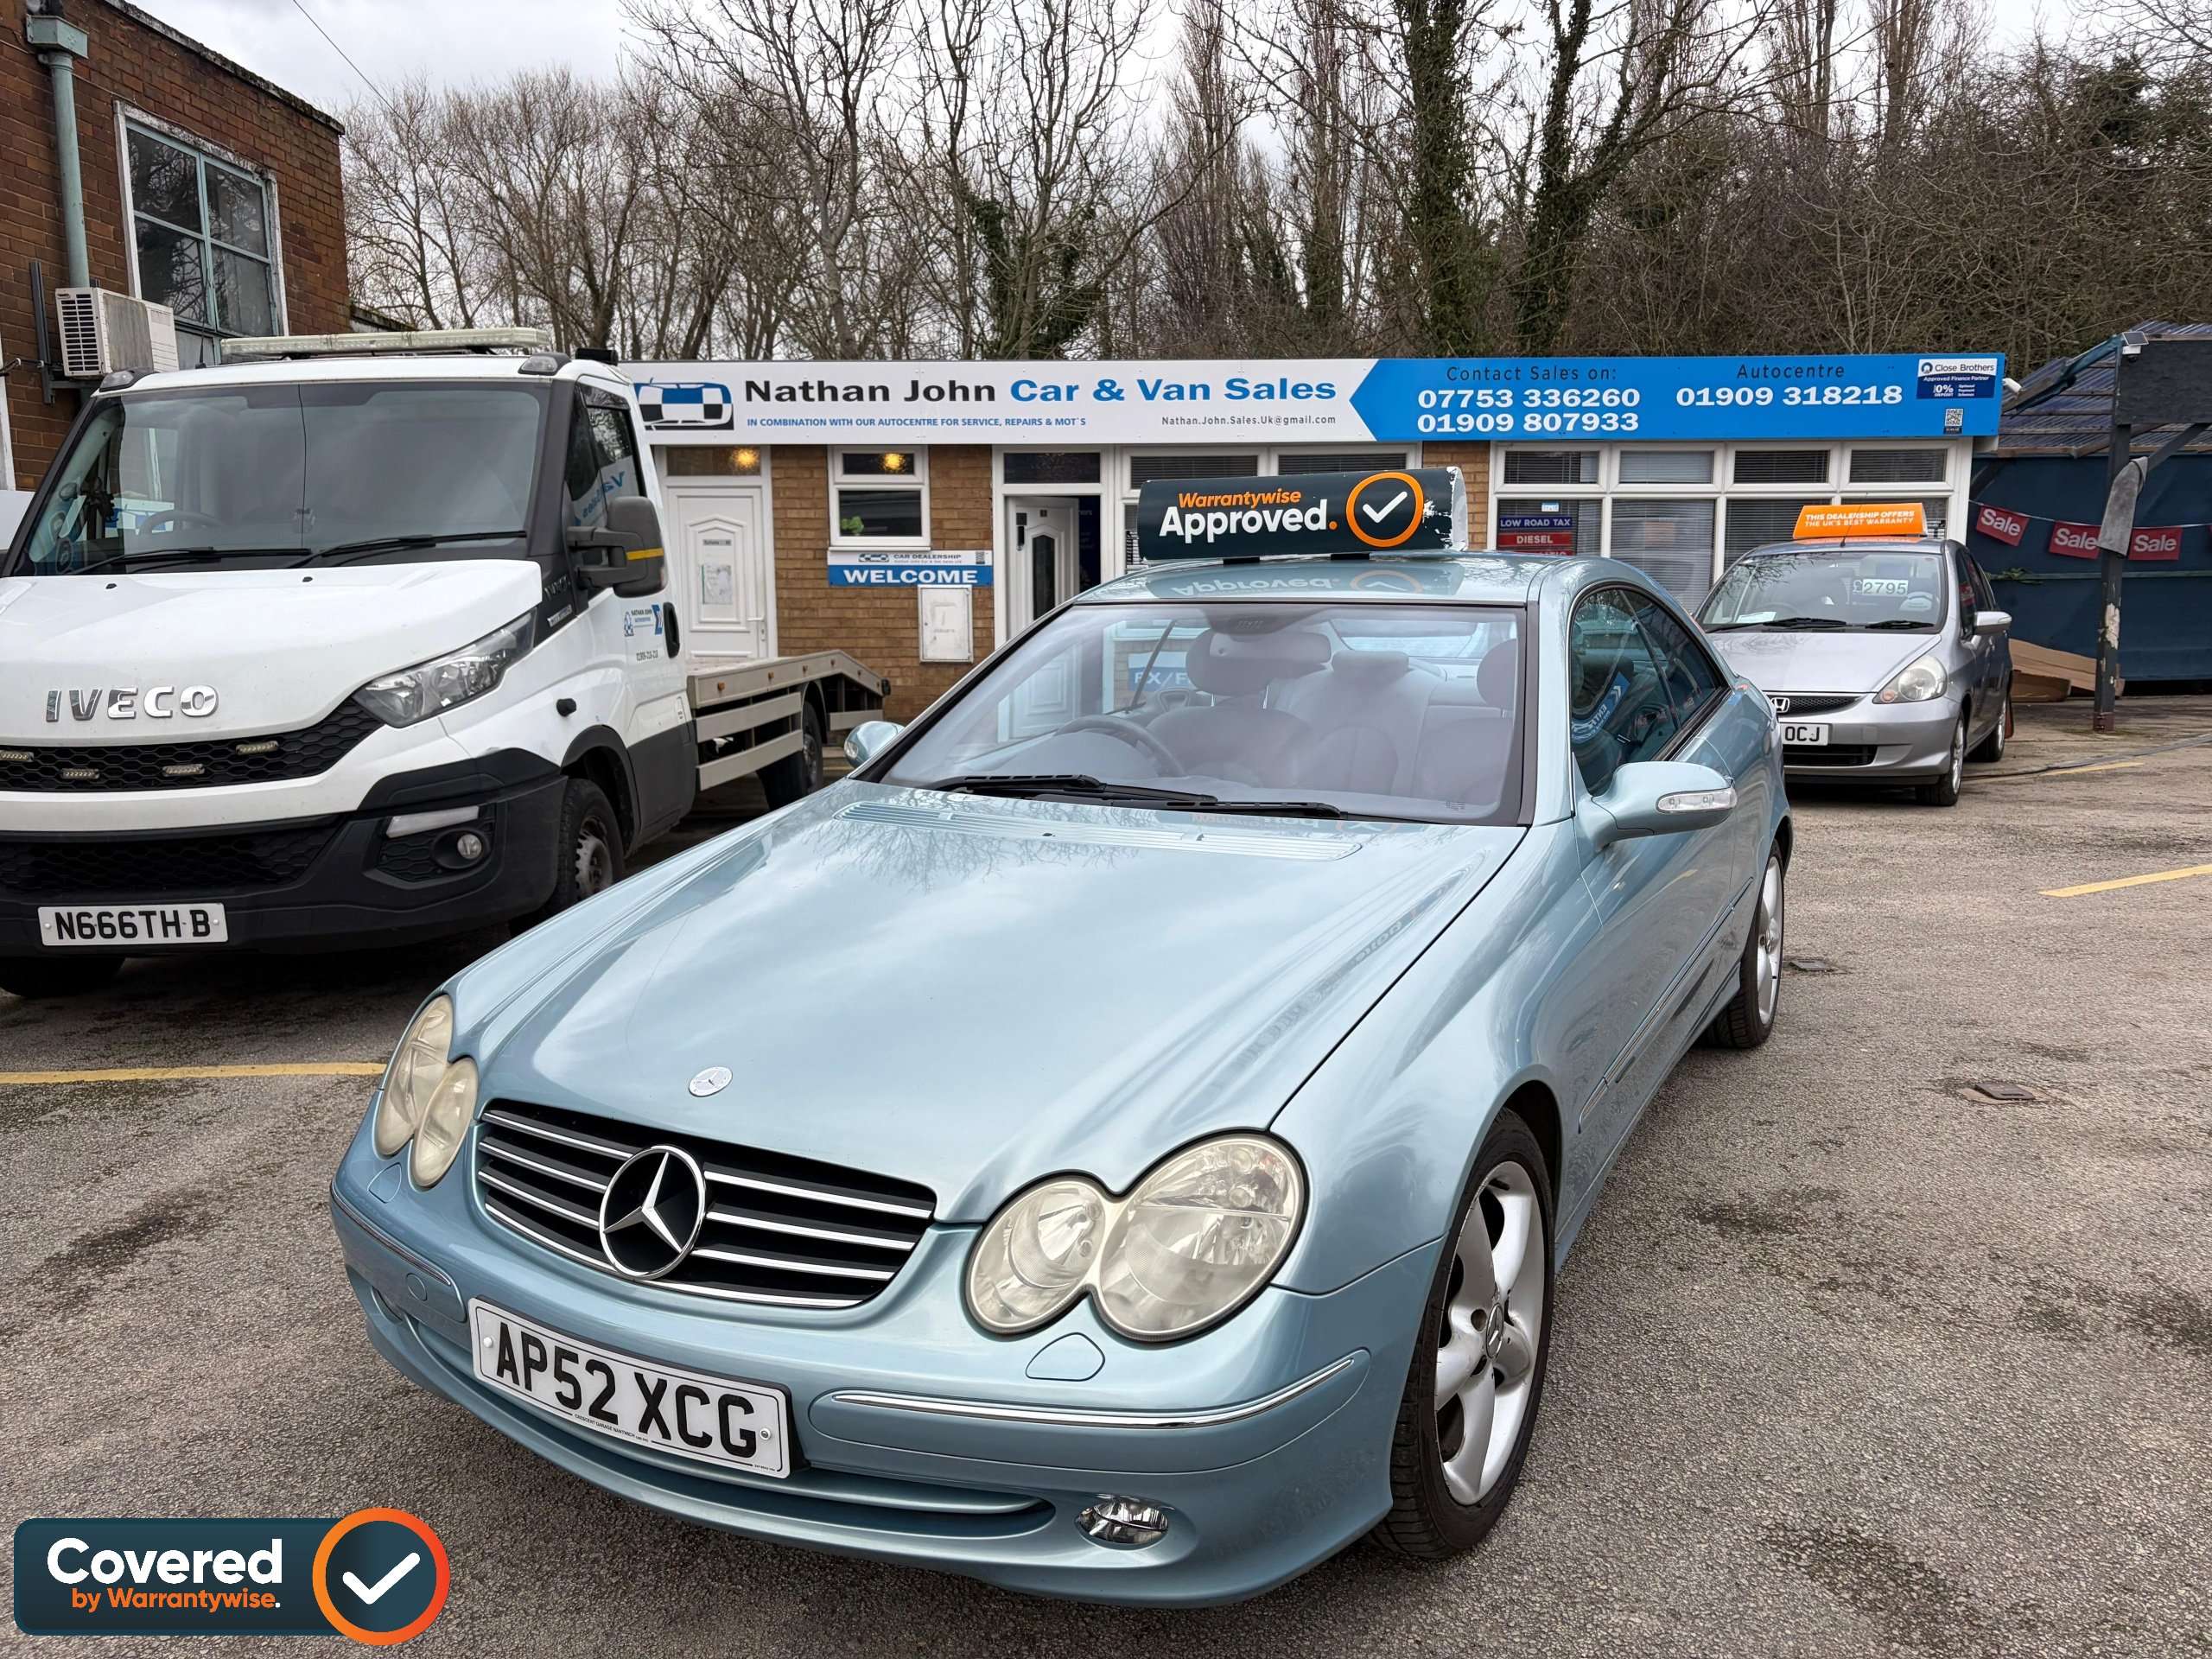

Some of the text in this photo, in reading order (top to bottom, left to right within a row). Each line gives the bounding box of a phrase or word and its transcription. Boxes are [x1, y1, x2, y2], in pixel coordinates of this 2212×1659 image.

[1446, 365, 1617, 381] Contact Sales on:
[1737, 364, 1845, 378] Autocentre
[745, 378, 1336, 402] Nathan John Car & Van Sales
[1418, 388, 1640, 408] 07753 336260
[1676, 385, 1902, 406] 01909 318218
[962, 418, 1002, 428] SERVICE,
[1161, 416, 1336, 425] Nathan.John.Sales.Uk@gmail.com
[1417, 412, 1638, 432] 01909 807933
[1178, 488, 1301, 508] Warrantywise
[1160, 499, 1338, 543] Approved.
[1524, 518, 1550, 527] ROAD
[1827, 512, 1879, 520] DEALERSHIP
[1980, 508, 2021, 537] Sale
[2054, 528, 2097, 550] Sale
[2133, 534, 2177, 552] Sale
[843, 569, 978, 583] WELCOME
[46, 685, 219, 722] IVECO
[1784, 726, 1820, 742] OCJ
[496, 1322, 757, 1459] AP52 XCG
